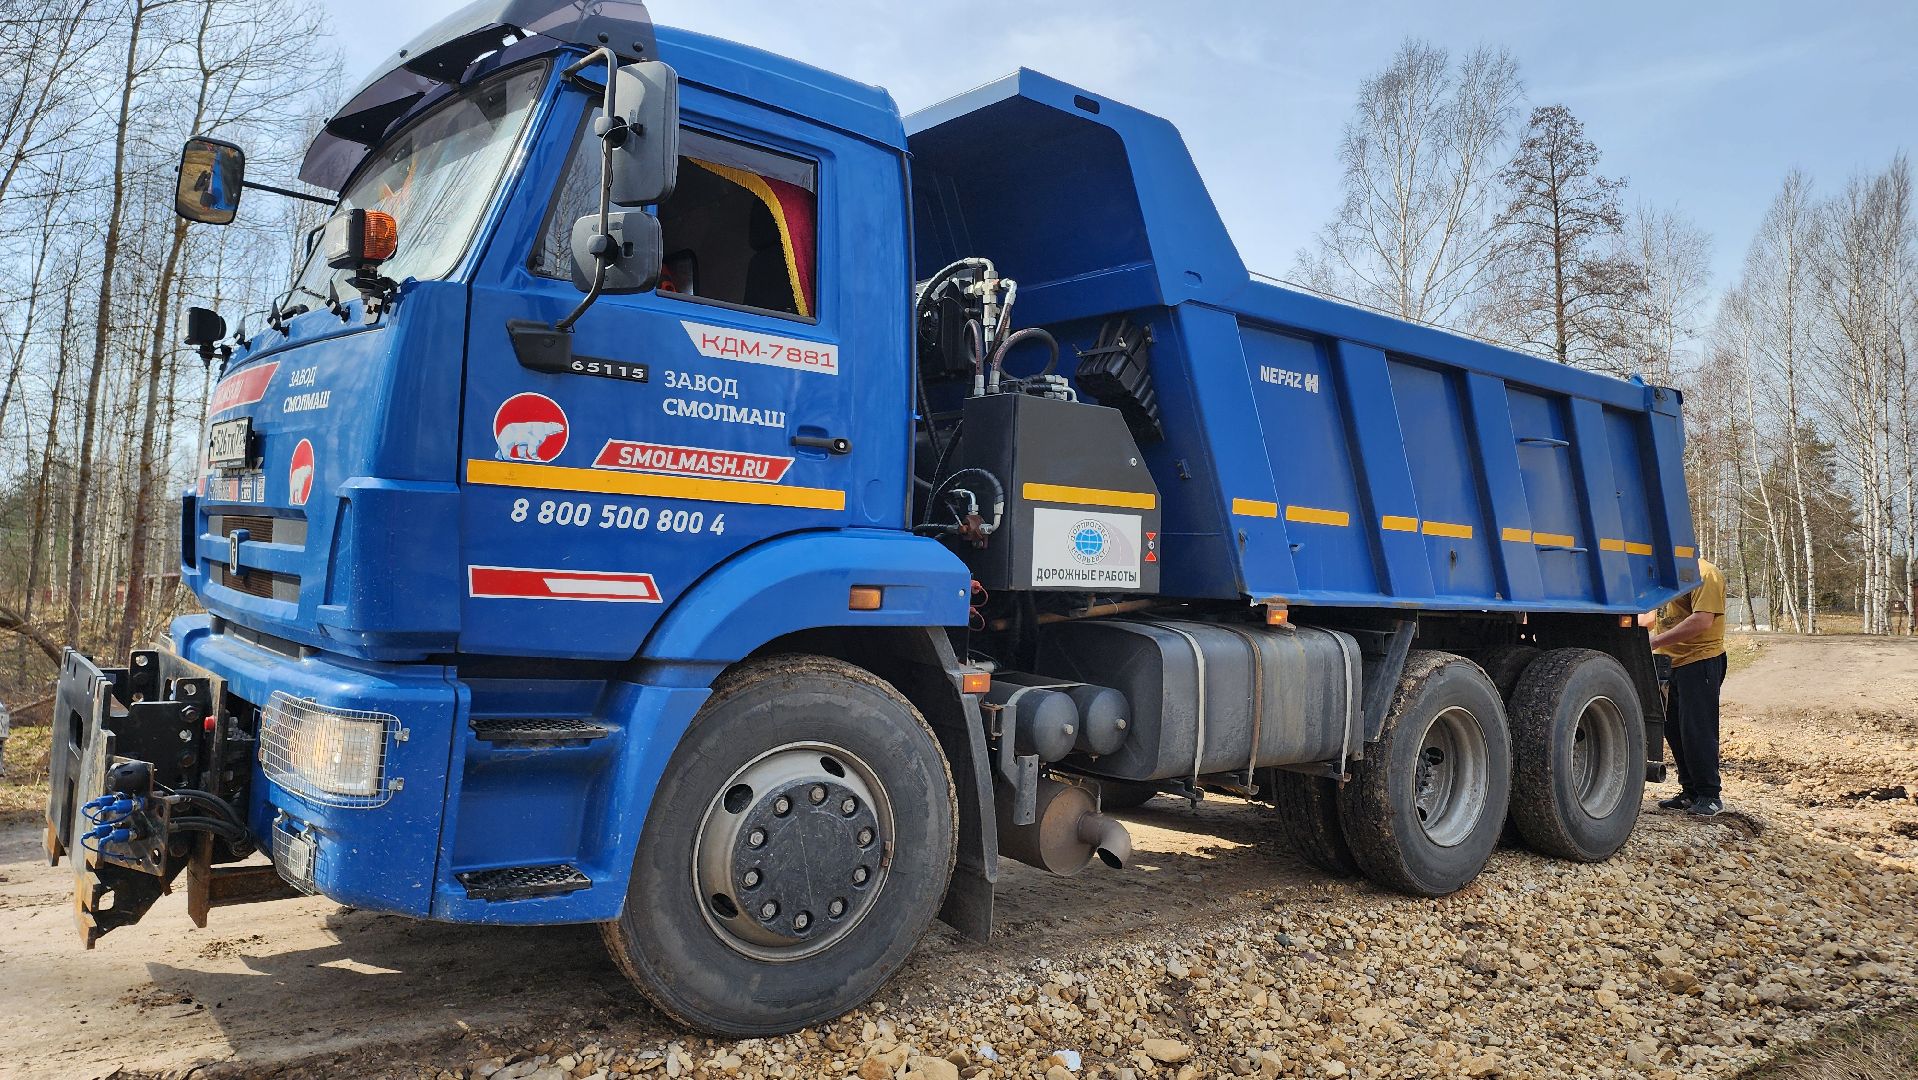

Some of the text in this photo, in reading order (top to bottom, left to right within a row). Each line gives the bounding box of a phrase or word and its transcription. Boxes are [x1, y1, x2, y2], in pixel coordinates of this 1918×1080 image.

[701, 332, 835, 370] КДМ-7881
[288, 366, 318, 387] ЗАВОД
[571, 359, 645, 380] 65115
[1260, 364, 1302, 388] NEFAZ
[664, 370, 739, 399] ЗАВОД
[283, 390, 331, 413] СМОЛМАШ
[662, 398, 786, 429] СМОЛМАШ
[617, 446, 770, 478] SMOLMASH.RU
[511, 498, 725, 535] 8 800 500 800 4
[1036, 568, 1137, 583] ДОРОЖНЫЕ РАБОТЫ
